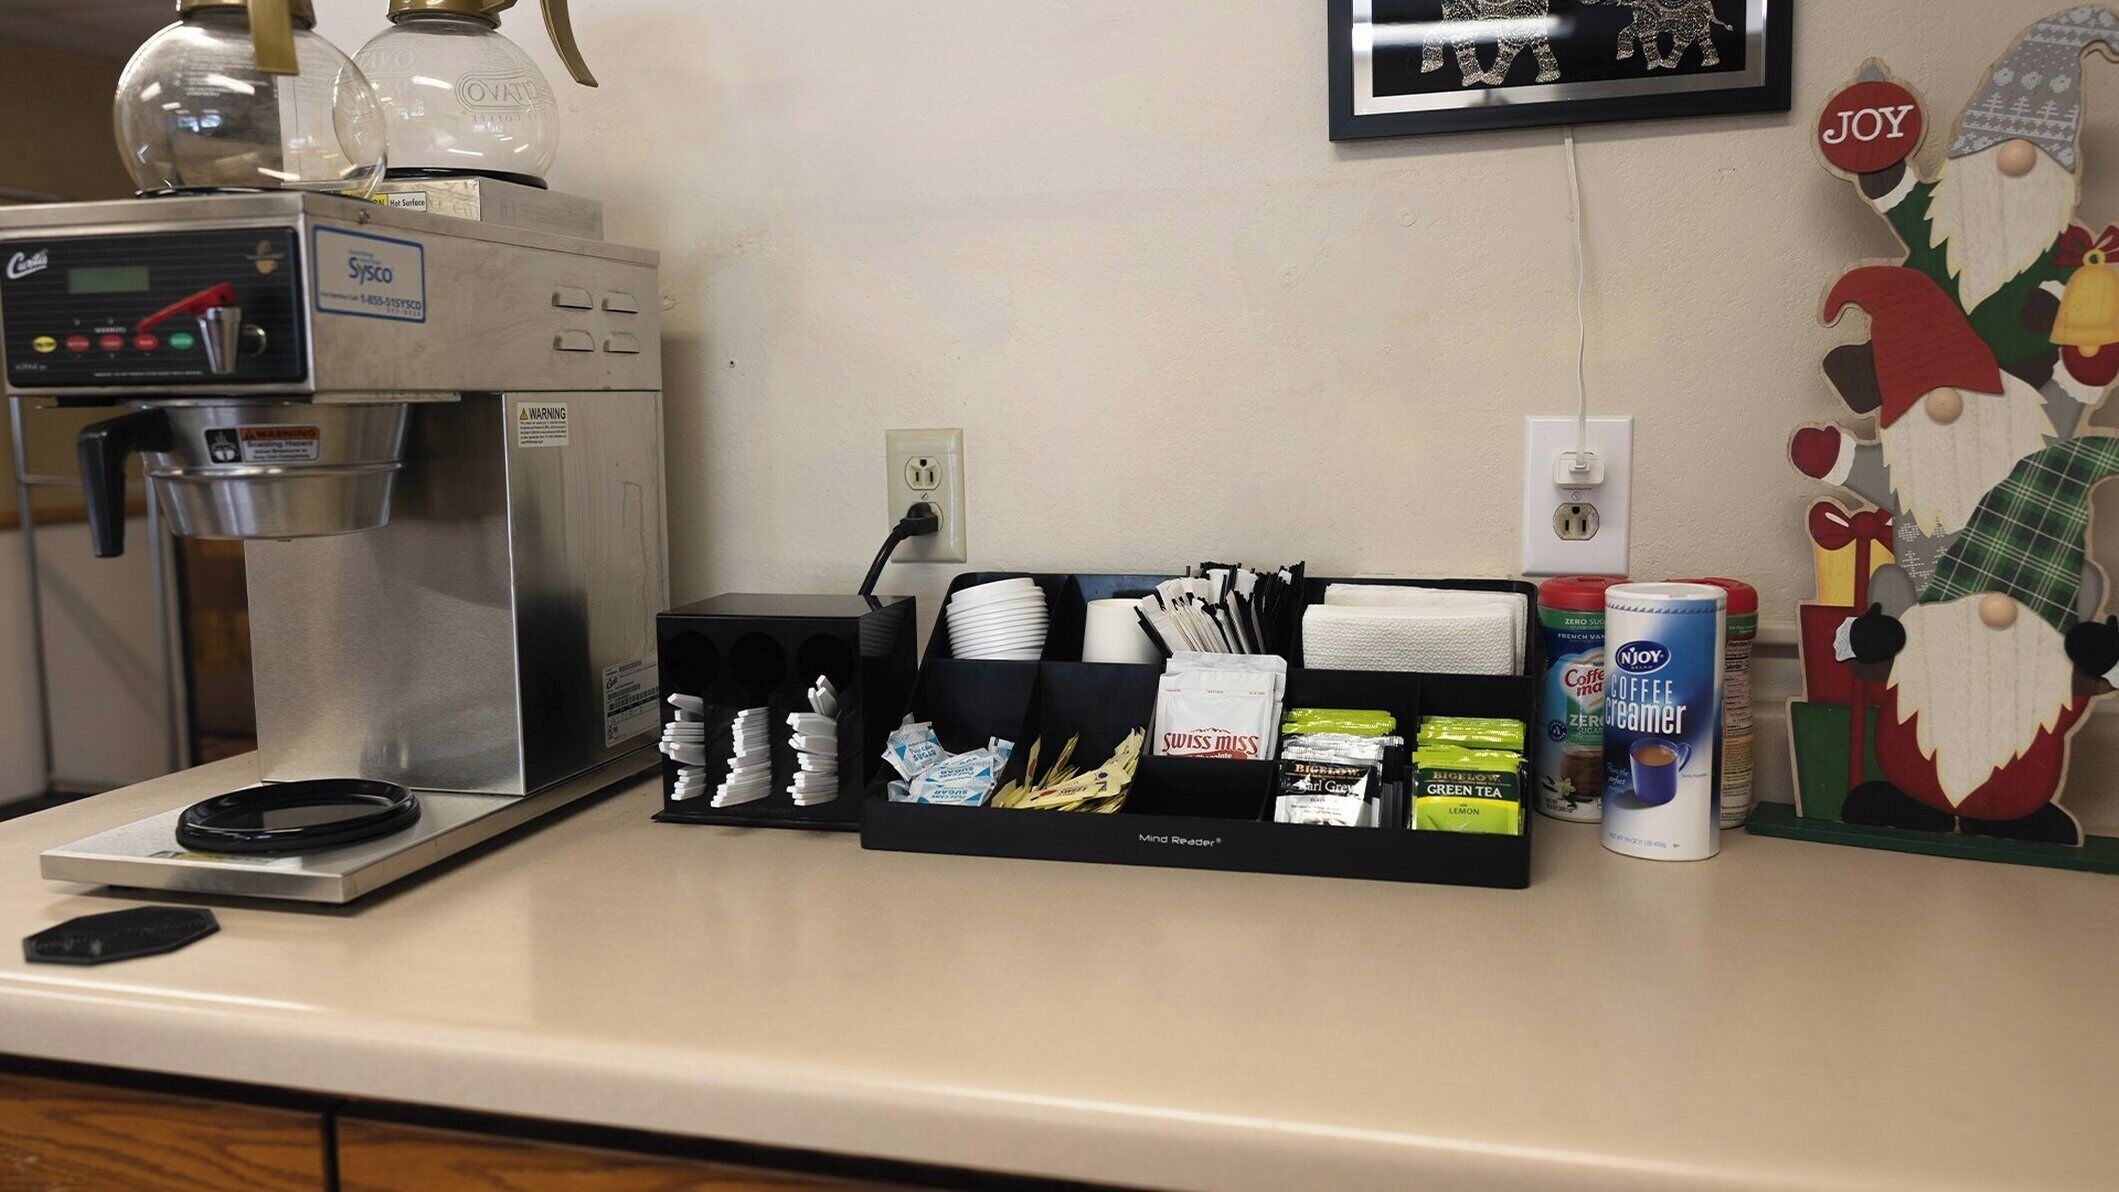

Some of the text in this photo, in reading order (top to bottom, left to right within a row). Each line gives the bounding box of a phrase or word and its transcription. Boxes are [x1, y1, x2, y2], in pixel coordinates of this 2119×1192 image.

[1823, 105, 1914, 144] JOY
[348, 257, 394, 285] Sysco
[529, 407, 567, 420] WARNING
[1557, 632, 1588, 640] FRENCH
[1564, 667, 1605, 687] Coffe
[1576, 682, 1603, 697] ma
[1611, 673, 1674, 705] COFFEE
[1605, 696, 1687, 735] creamer
[912, 749, 937, 762] SUGAR
[1294, 763, 1361, 777] BIGELOW
[1432, 771, 1501, 783] BIGELOW
[1427, 783, 1503, 799] GREEN TEA
[1448, 807, 1480, 816] LEMON
[1139, 833, 1168, 844] Mind
